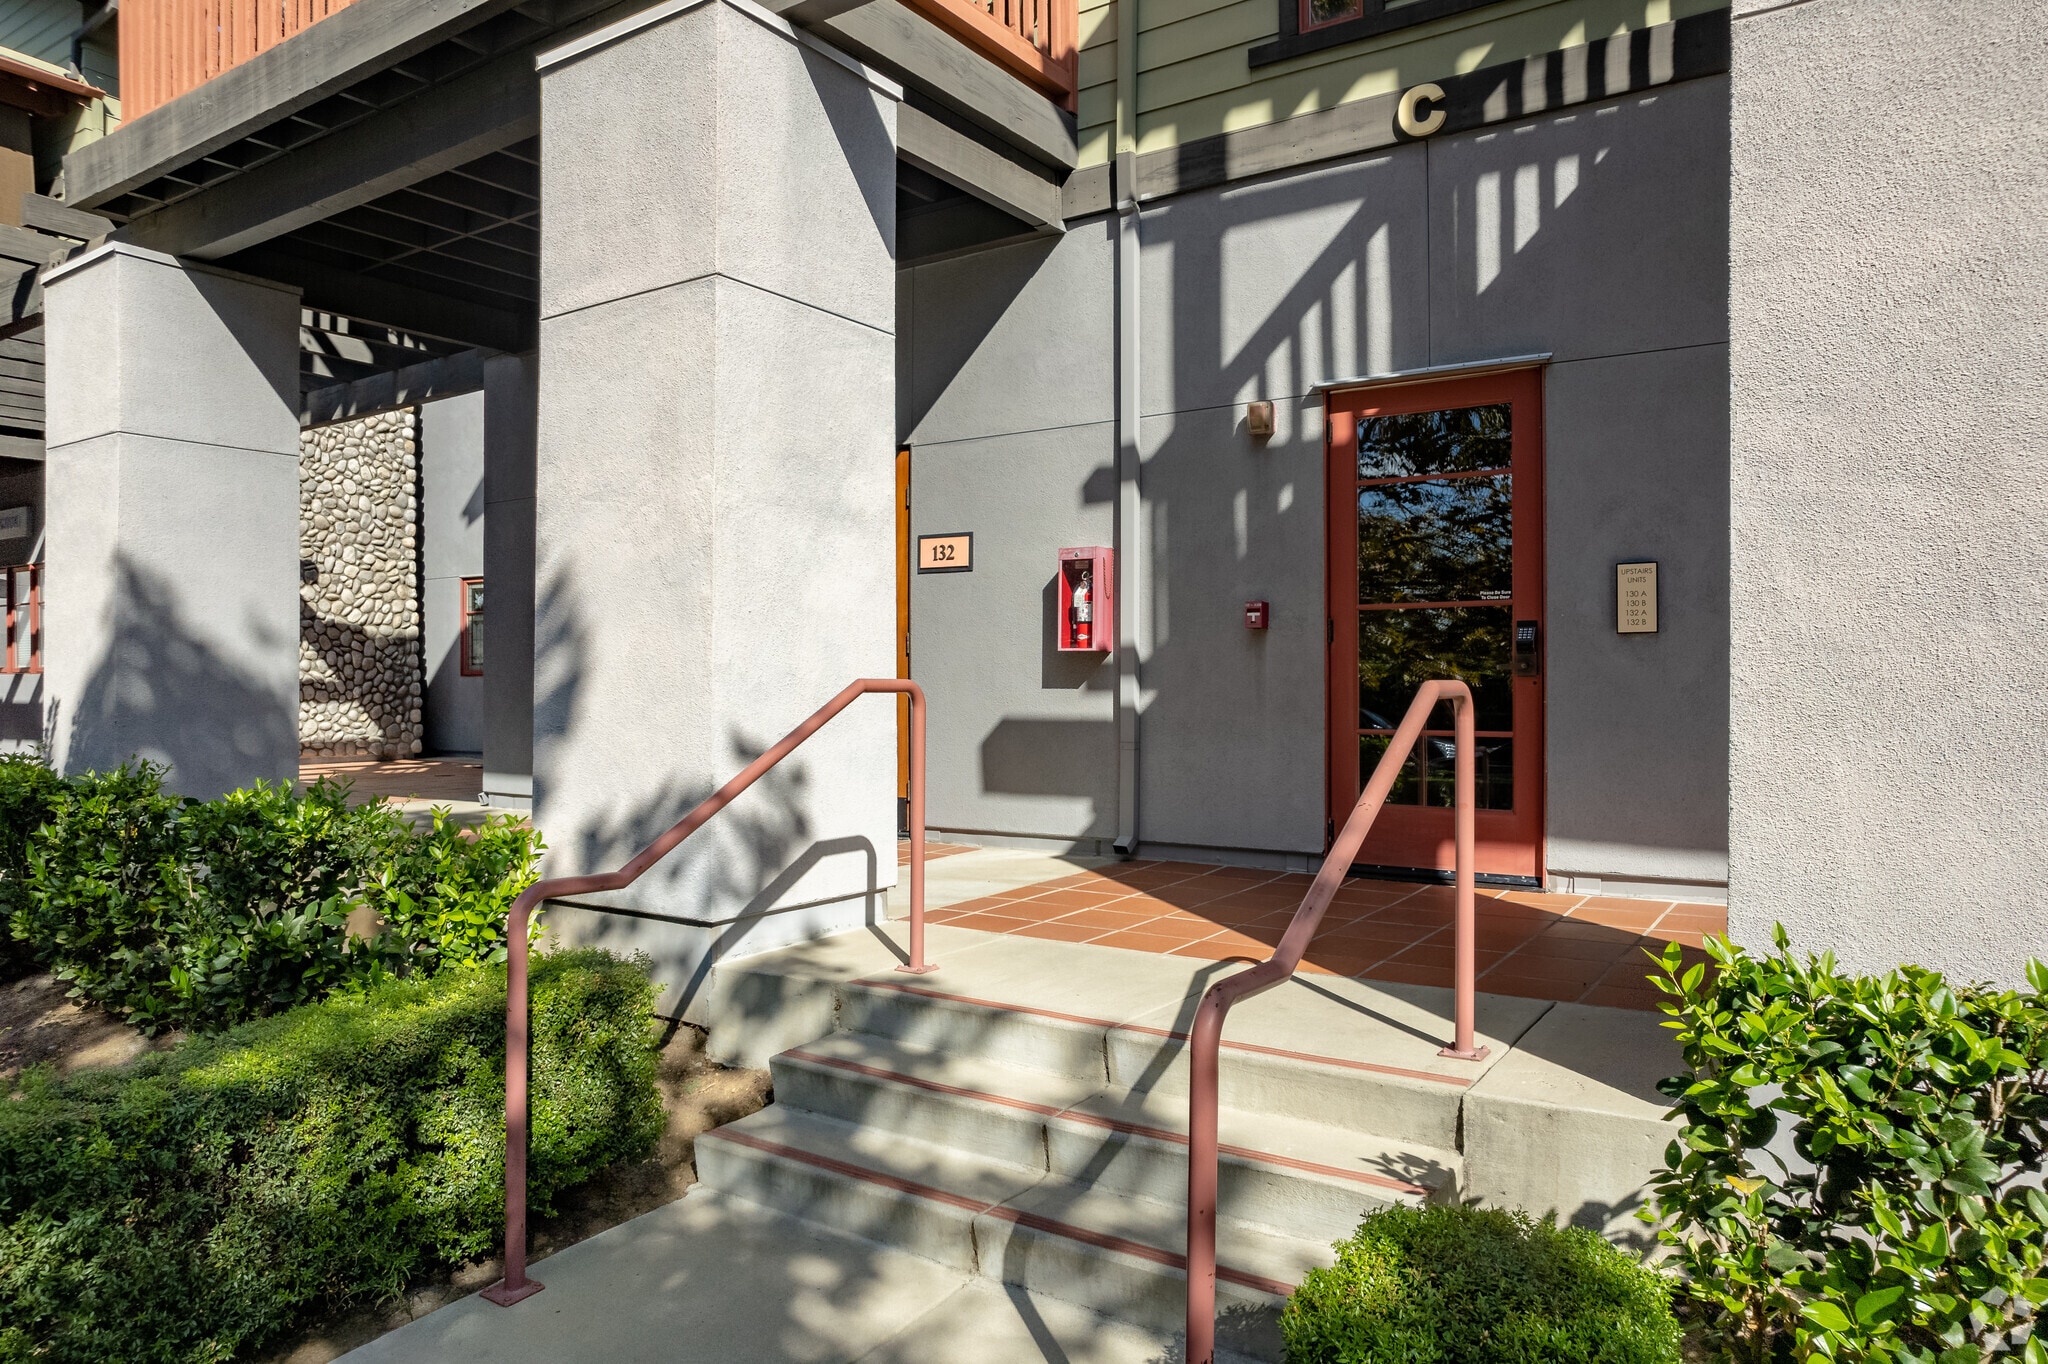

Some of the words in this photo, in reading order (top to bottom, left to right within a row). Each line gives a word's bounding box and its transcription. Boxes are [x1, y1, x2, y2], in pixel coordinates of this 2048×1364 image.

[1398, 83, 1447, 136] C
[933, 544, 955, 561] 132
[1621, 567, 1653, 575] UPSTAIRS
